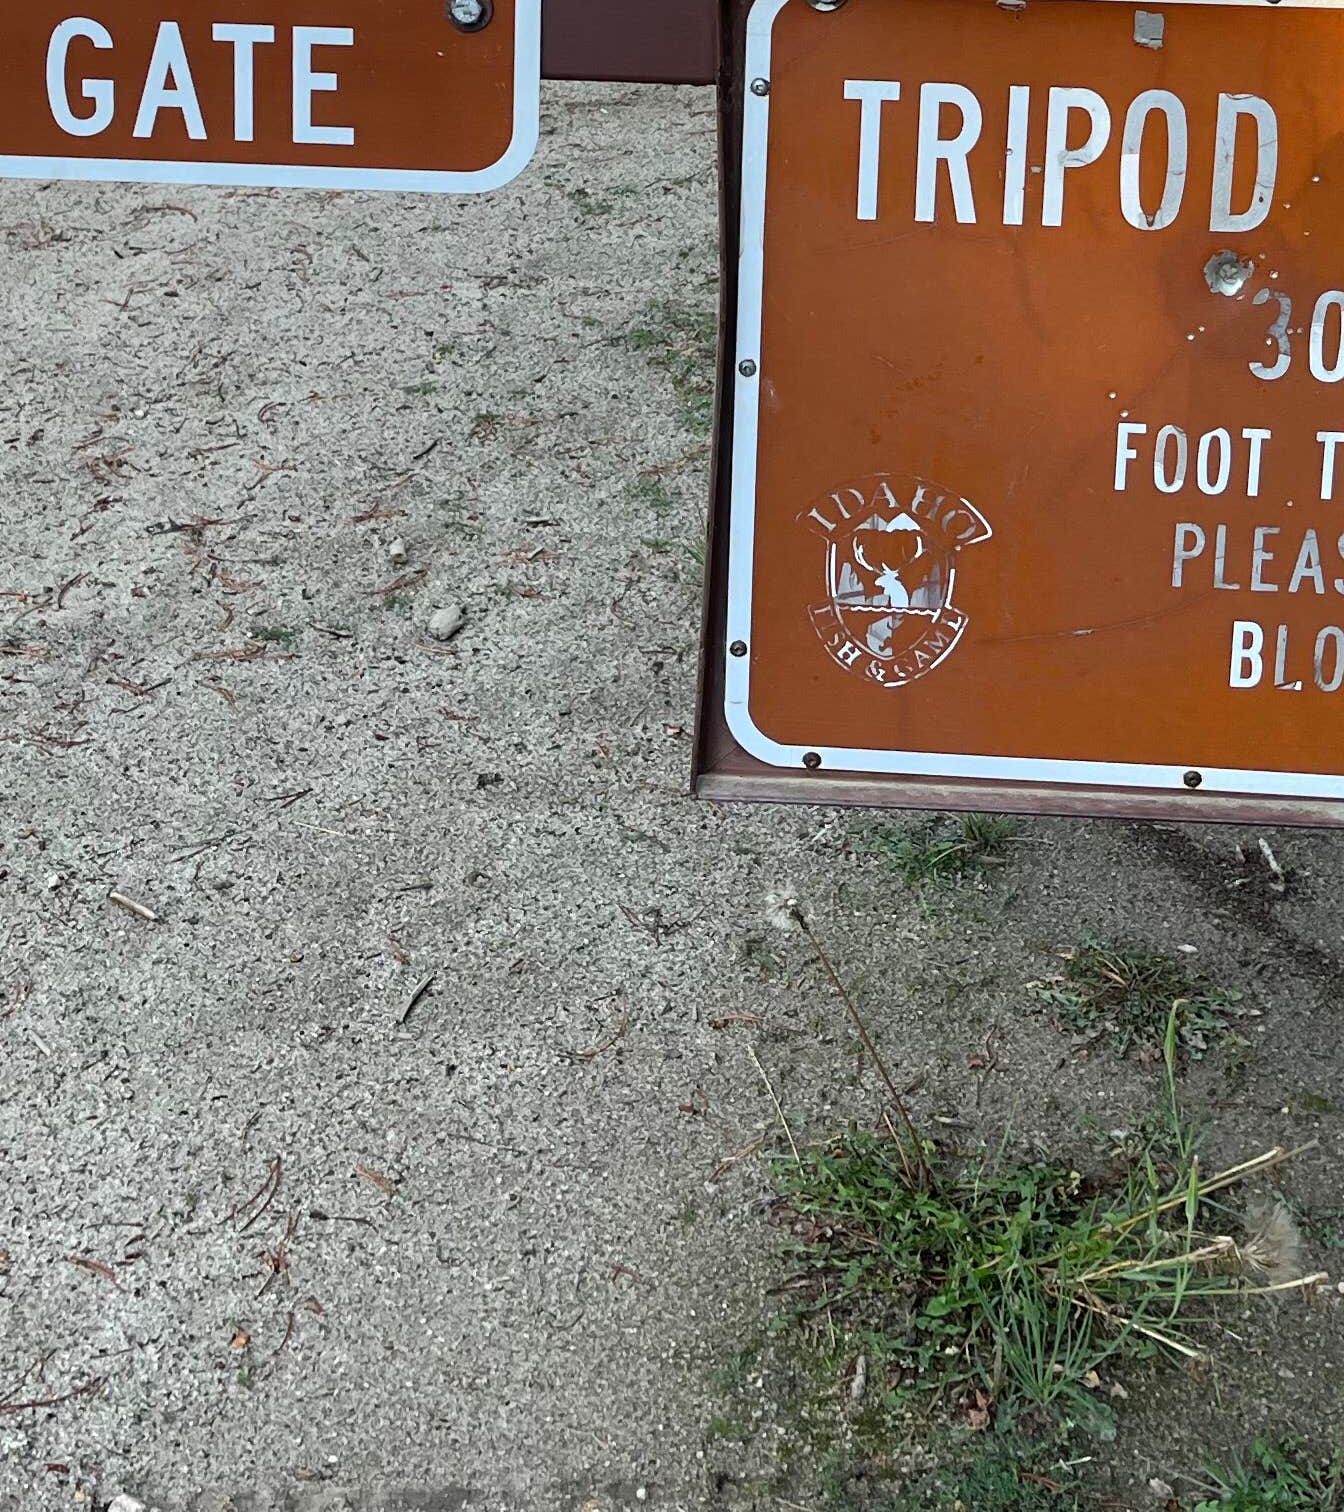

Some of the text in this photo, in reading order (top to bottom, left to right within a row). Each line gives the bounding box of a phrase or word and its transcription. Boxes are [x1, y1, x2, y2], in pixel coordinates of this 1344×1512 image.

[46, 17, 354, 145] GATE
[844, 80, 1278, 232] TRIPOD
[1114, 423, 1272, 496] FOOT
